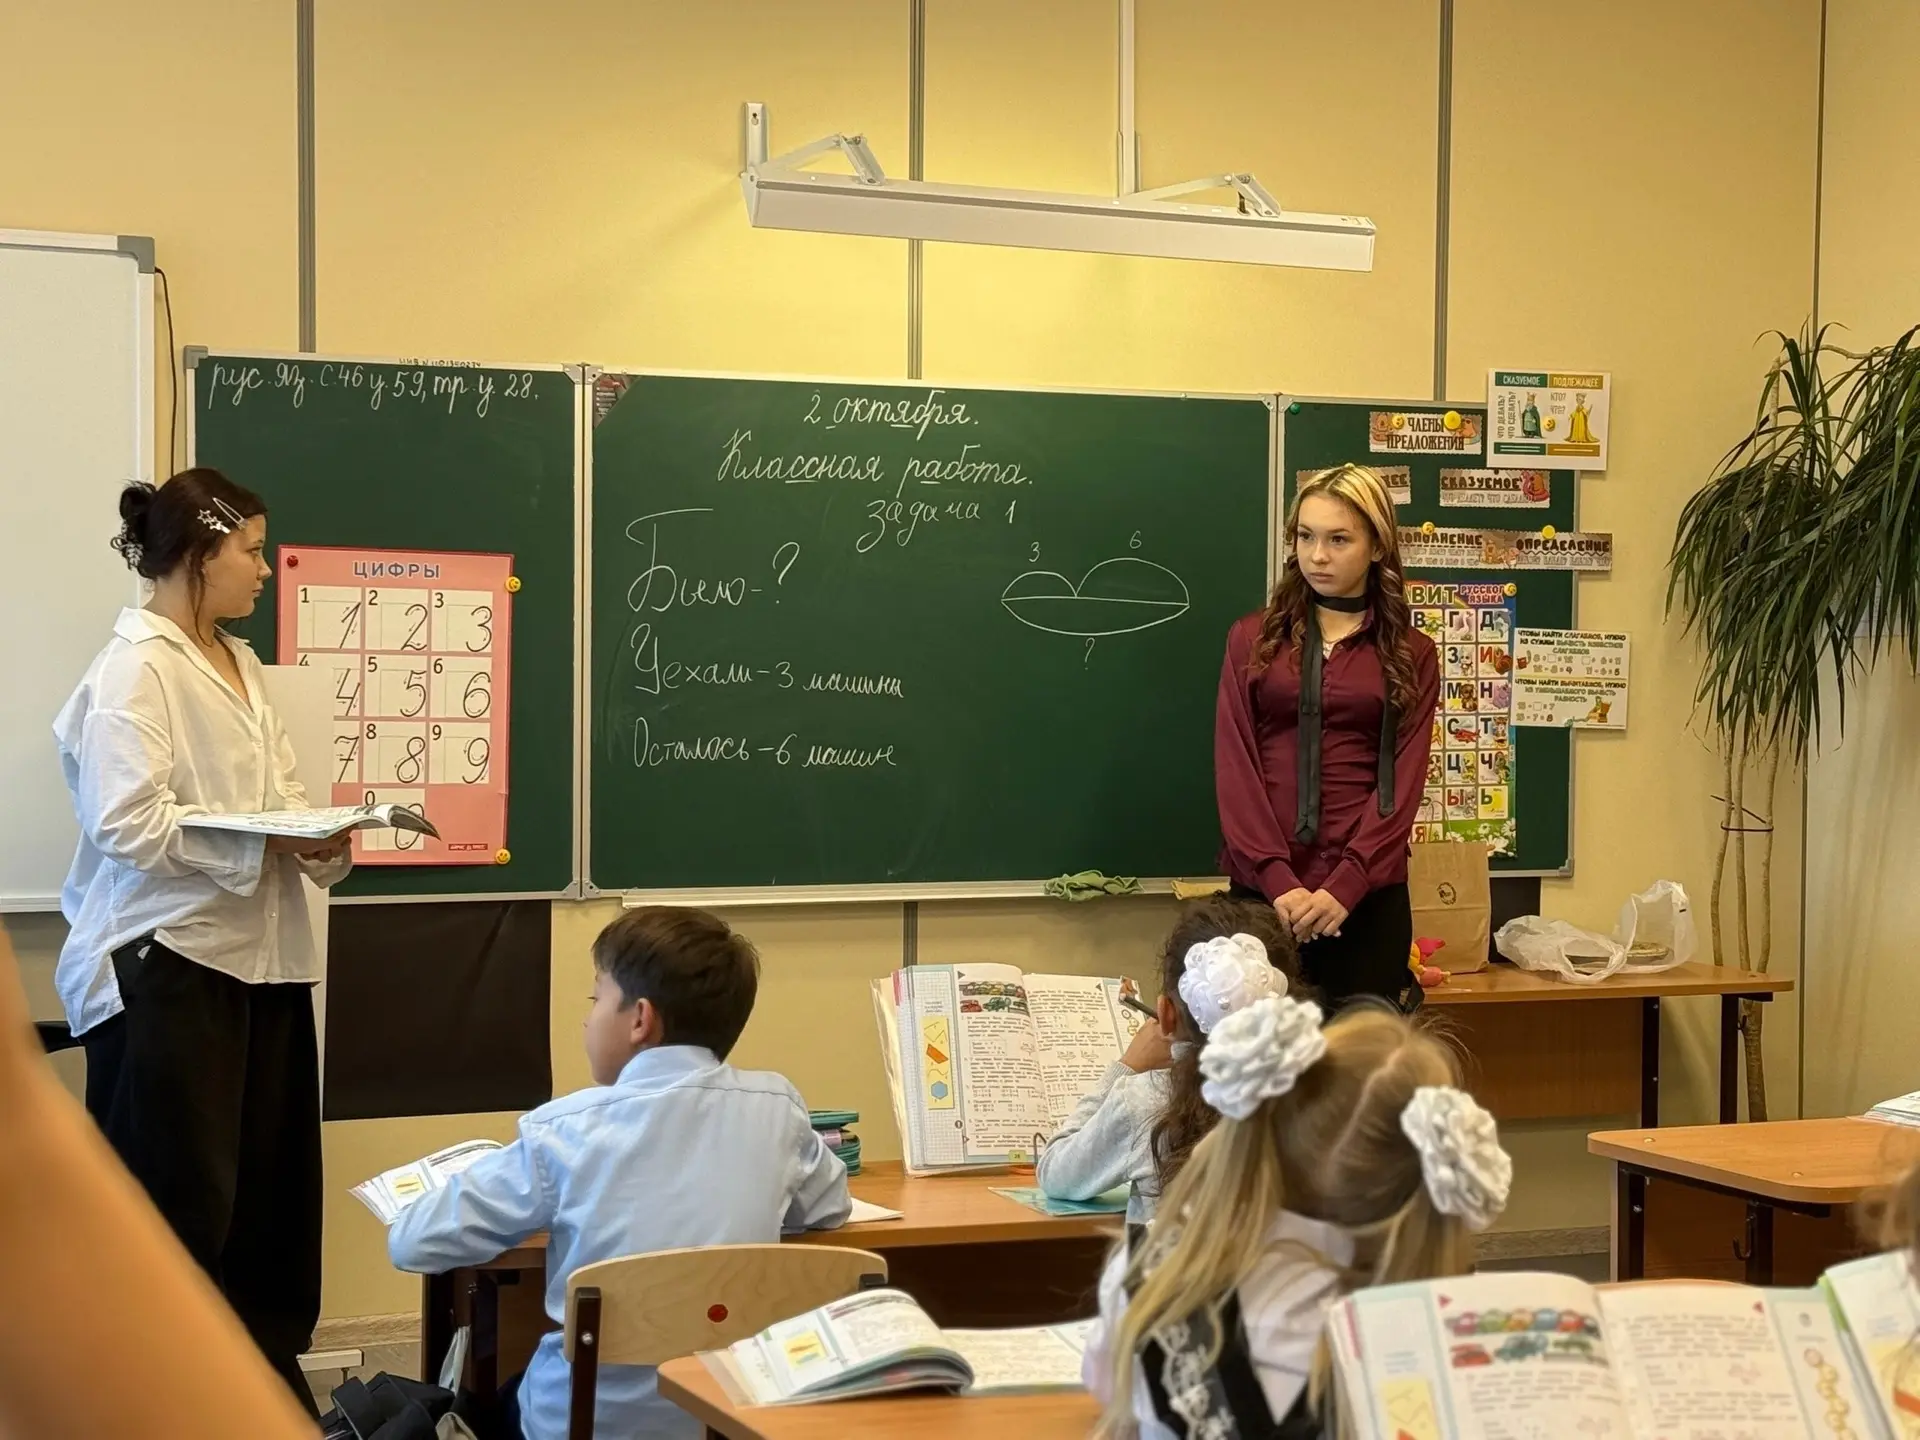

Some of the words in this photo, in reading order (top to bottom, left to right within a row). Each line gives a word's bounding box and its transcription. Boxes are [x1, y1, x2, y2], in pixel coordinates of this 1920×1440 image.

[1503, 375, 1541, 386] СКАЗУЕМОЕ
[1553, 377, 1599, 388] ПОДЛЕЖАЩЕЕ
[803, 394, 821, 424] 2
[1407, 417, 1444, 433] ЧЛЕНЫ
[1386, 434, 1465, 451] ПРЕДЛОЖЕНИЯ
[718, 428, 885, 482] Классная
[1441, 476, 1521, 490] СКАЗУЕМОЕ
[1005, 500, 1016, 524] 1
[1129, 530, 1142, 550] 6
[1516, 538, 1610, 552] ОПРЕДЕЛЕНИЕ
[1028, 541, 1041, 563] 3
[353, 561, 440, 579] ЦИФРЫ
[300, 588, 310, 603] 1
[368, 590, 378, 606] 2
[1461, 585, 1506, 595] РУССКОГ
[434, 592, 445, 608] 3
[1469, 594, 1504, 604] ЯЗЫКА
[341, 602, 361, 649] 1
[401, 604, 428, 651] 2
[1413, 611, 1426, 628] В
[1449, 611, 1460, 628] Г
[1480, 611, 1495, 631] Д
[465, 606, 493, 653] 3
[1480, 646, 1493, 663] И
[367, 657, 378, 673] 5
[433, 658, 444, 674] 6
[335, 668, 361, 716] 4
[399, 670, 427, 717] 5
[462, 672, 491, 719] 6
[1447, 682, 1462, 700] М
[1480, 681, 1493, 699] Н
[366, 723, 377, 740] 8
[432, 724, 442, 741] 9
[1447, 718, 1460, 735] С
[1480, 718, 1492, 734] Т
[334, 735, 360, 783] 7
[397, 736, 426, 784] 8
[462, 737, 490, 784] 9
[1447, 753, 1461, 774] Ц
[1480, 753, 1493, 770] Ч
[1447, 789, 1465, 806] Ы
[1480, 788, 1493, 806] Ь
[1414, 826, 1426, 844] Я
